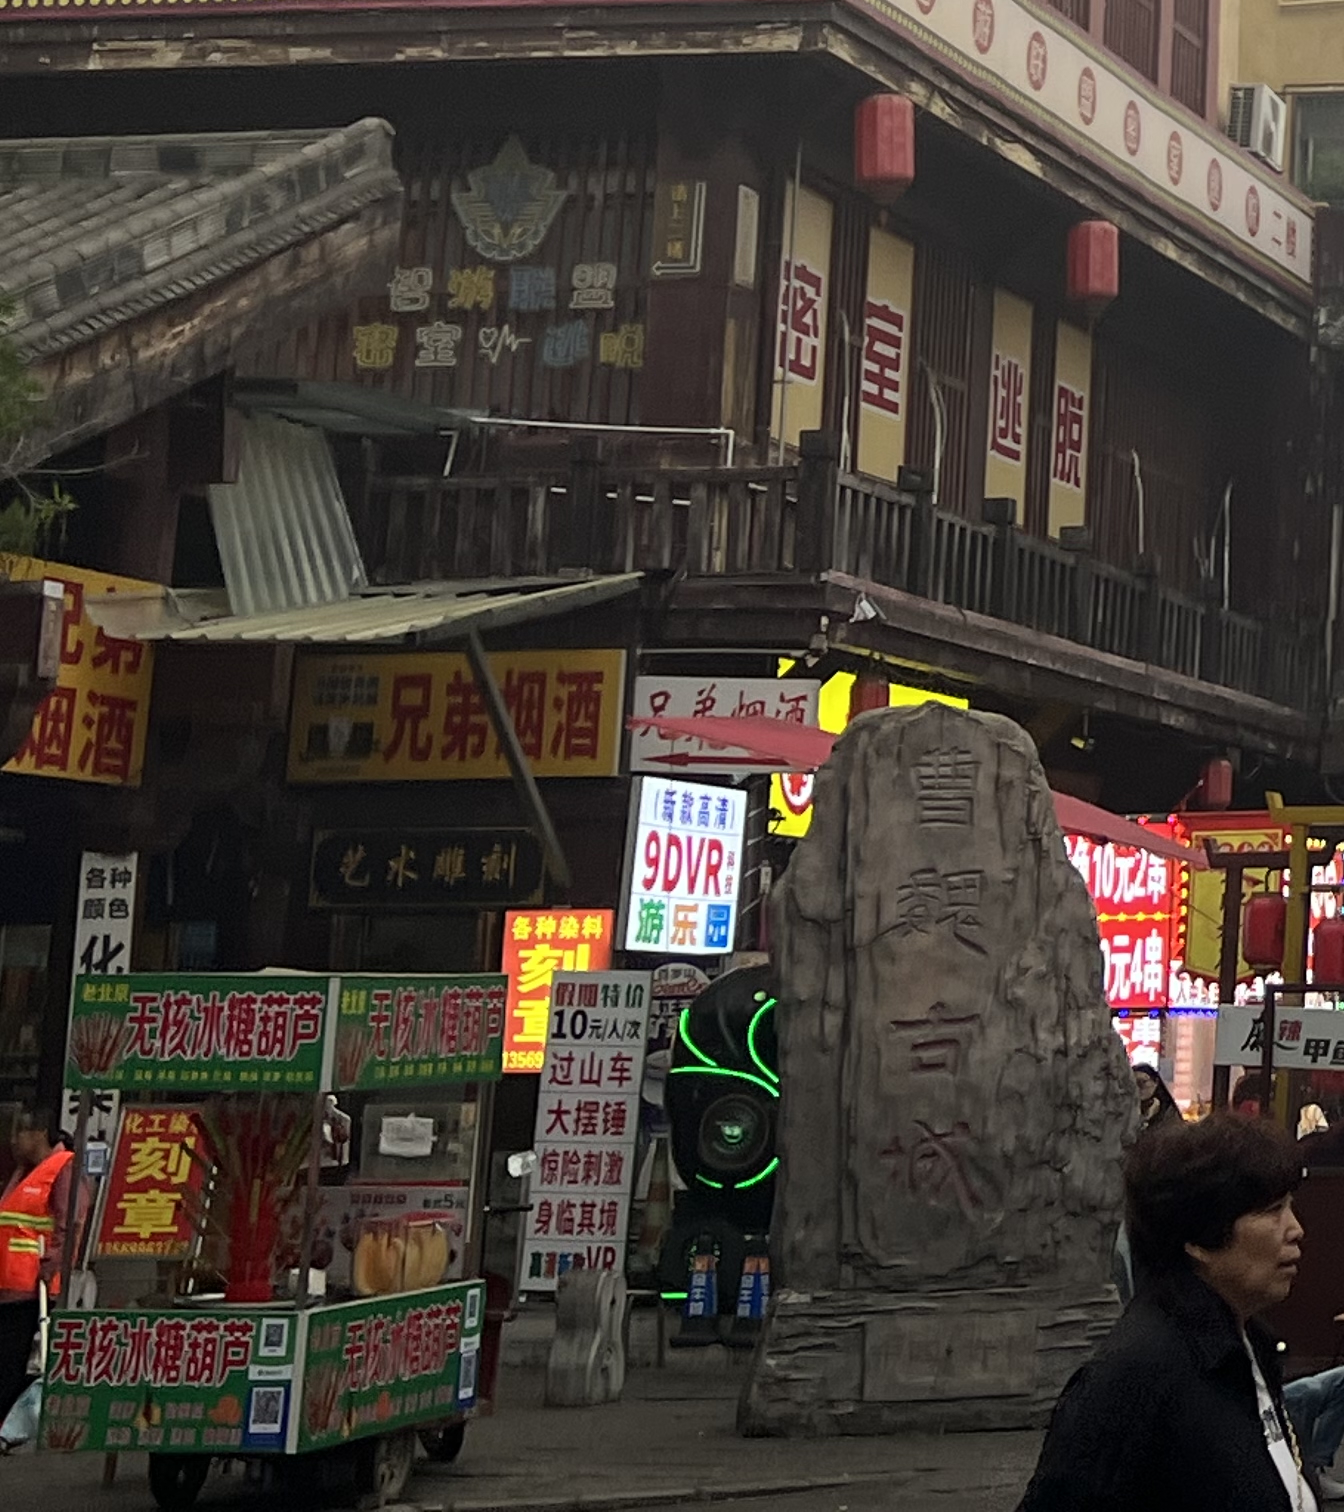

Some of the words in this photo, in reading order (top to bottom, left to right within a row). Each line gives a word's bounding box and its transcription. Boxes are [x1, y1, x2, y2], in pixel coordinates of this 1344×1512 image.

[353, 320, 462, 368] 密室
[543, 319, 645, 368] 逃脱
[382, 668, 606, 764] 兄弟烟酒
[85, 866, 132, 890] 各种
[642, 831, 724, 898] 9DVR
[512, 914, 604, 941] 各种染料
[555, 981, 644, 1009] 假期特价
[126, 991, 323, 1060] 无核冰糖葫芦
[369, 986, 505, 1062] 无核冰糖葫芦
[551, 1009, 642, 1042] 10元/人/次
[502, 1049, 544, 1070] 13569
[548, 1050, 634, 1088] 过山车
[546, 1099, 628, 1137] 大摆锤
[541, 1149, 623, 1187] 惊险刺激
[113, 1136, 197, 1240] 刻章
[535, 1201, 619, 1238] 身临其境
[50, 1318, 255, 1386] 无核冰糖葫芦
